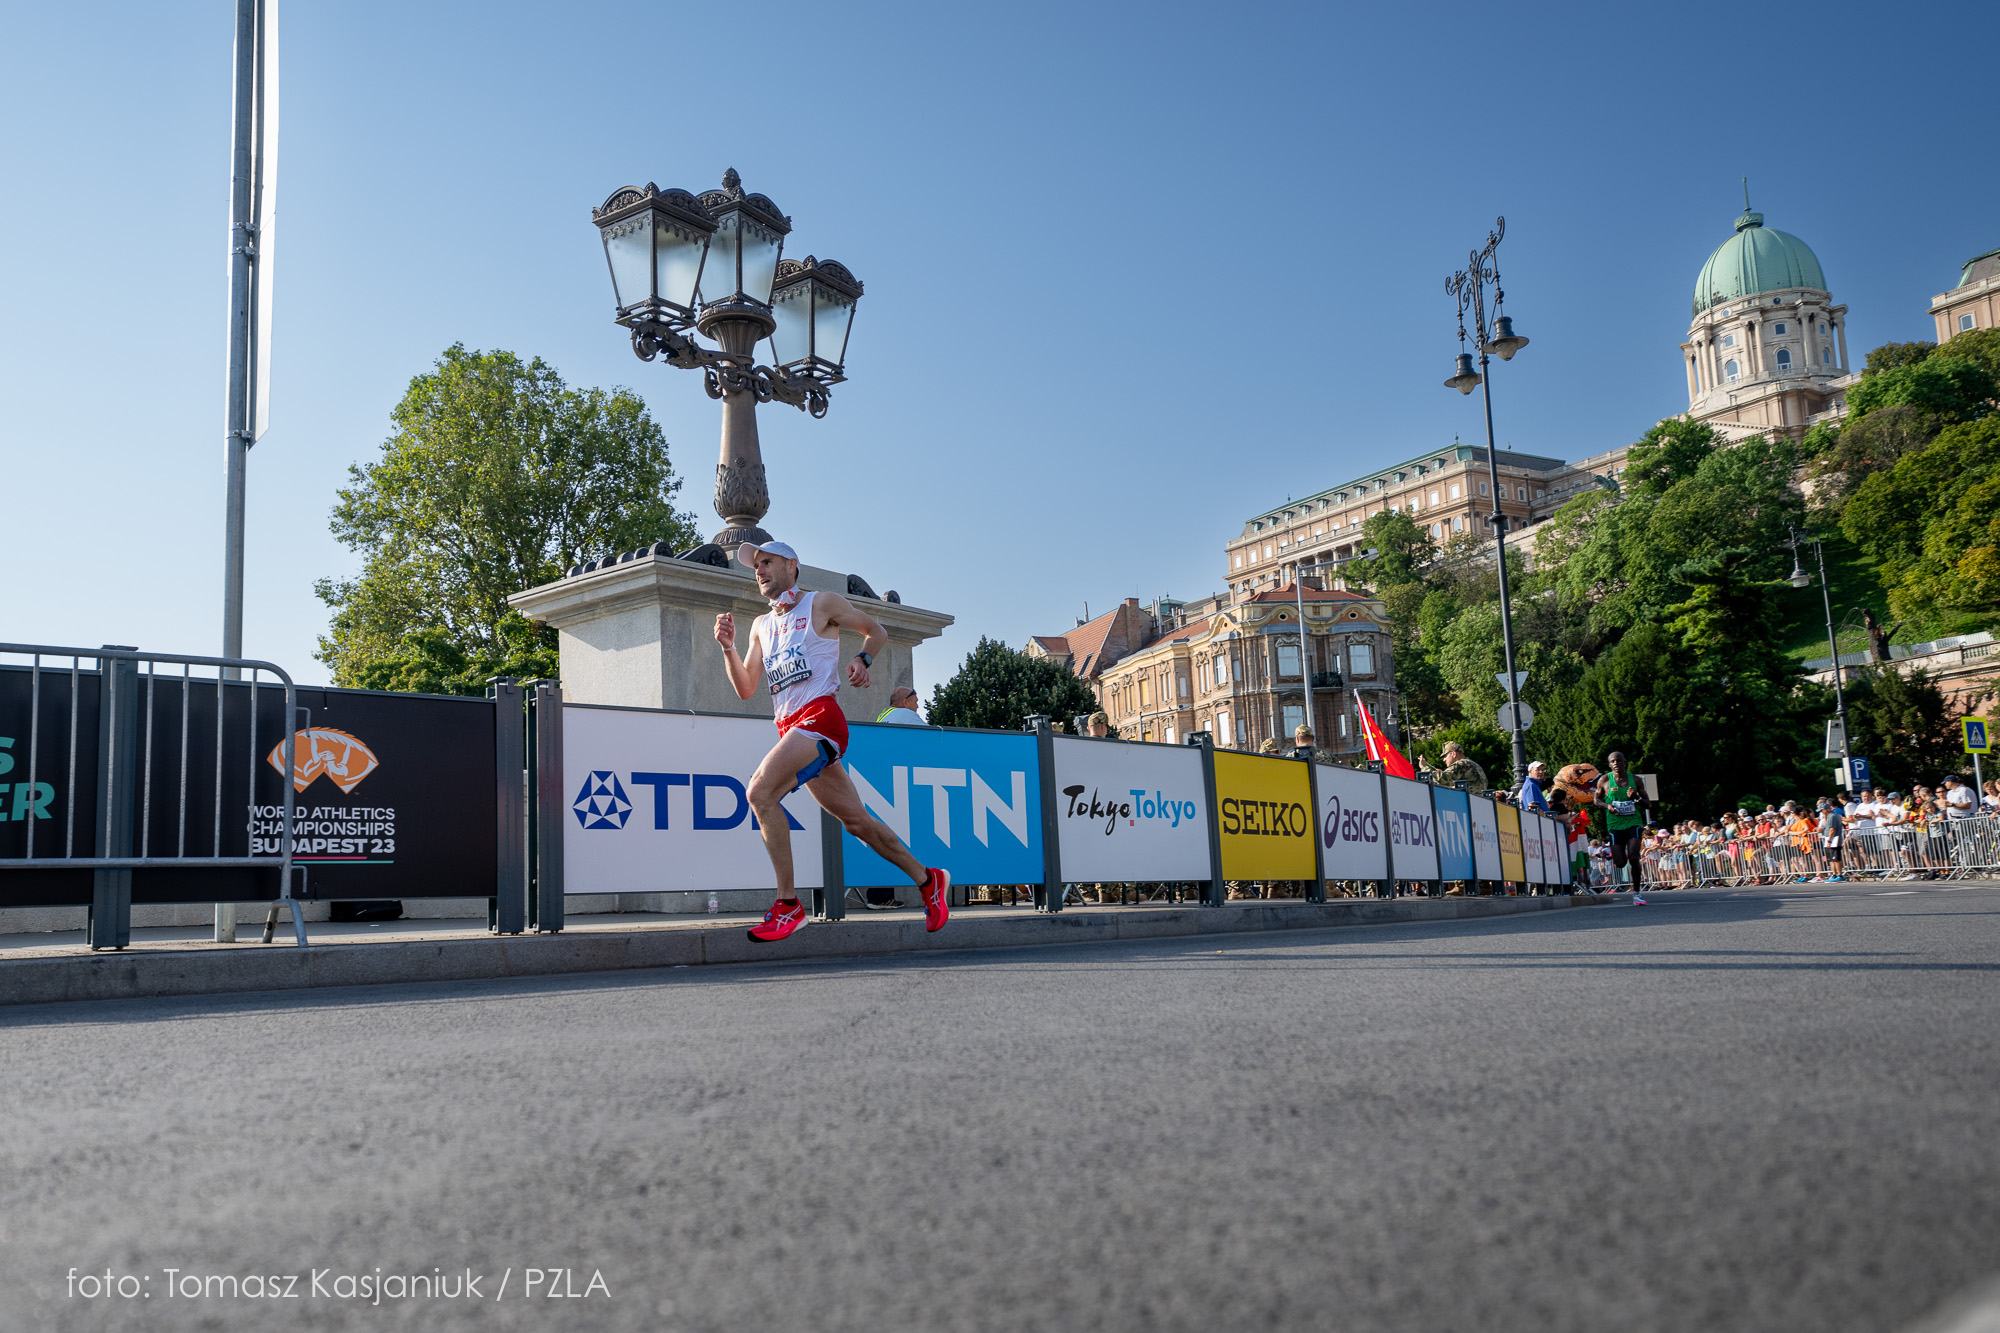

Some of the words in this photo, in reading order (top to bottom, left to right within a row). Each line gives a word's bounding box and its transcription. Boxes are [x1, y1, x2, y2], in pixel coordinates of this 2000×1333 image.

[771, 645, 803, 660] TDK
[767, 659, 807, 684] NOWICKI
[1854, 761, 1865, 778] P
[248, 806, 307, 818] WORD
[311, 807, 395, 820] ATHLETICS
[848, 763, 1028, 850] NTN
[1222, 797, 1307, 838] SEIKO
[247, 821, 395, 836] CHAMPIONSHIPS
[1342, 809, 1379, 843] asics
[1399, 811, 1433, 847] TDK
[1436, 809, 1470, 858] NTN
[371, 839, 395, 853] 23
